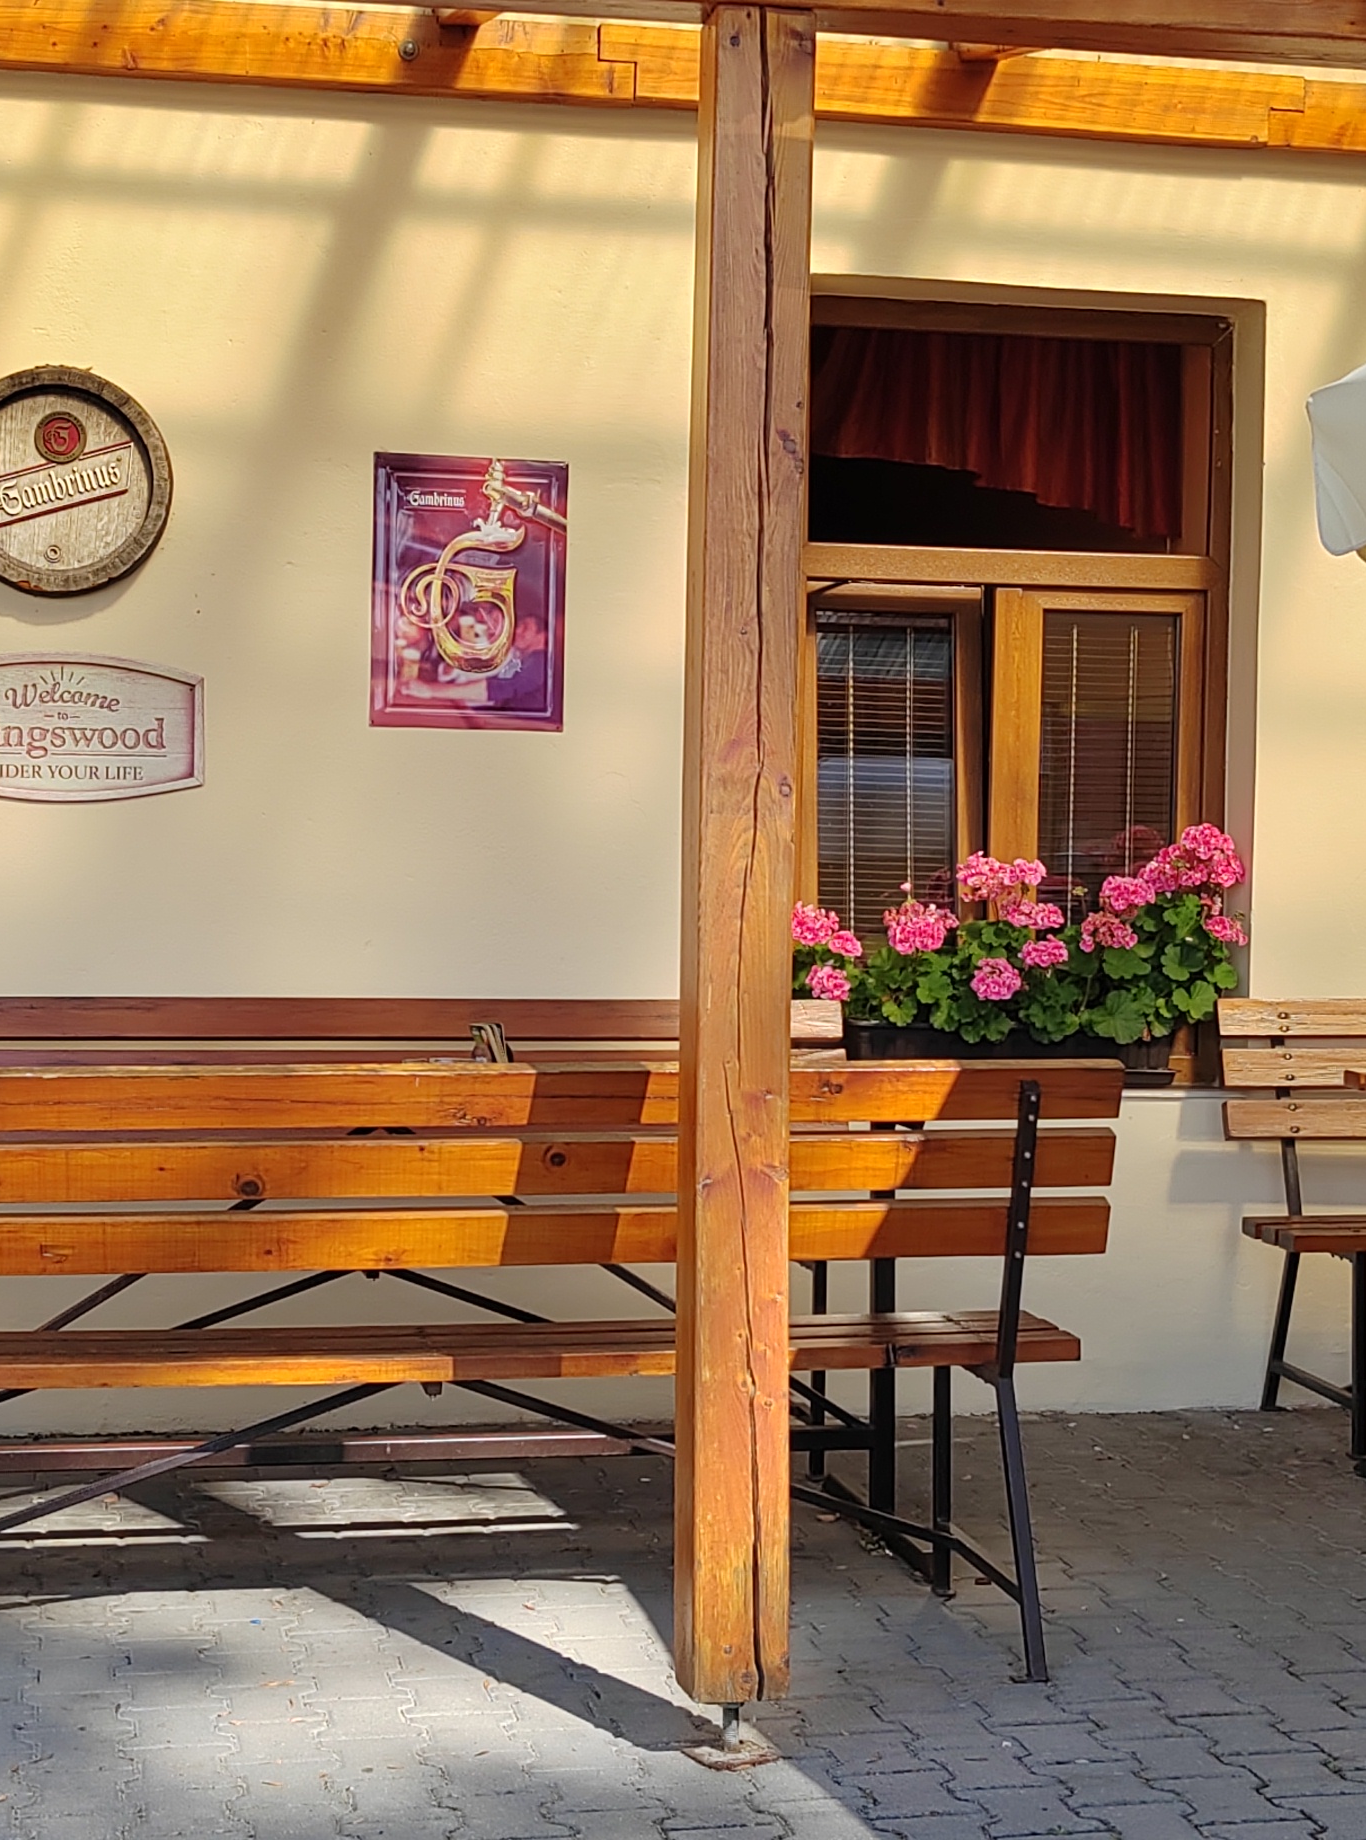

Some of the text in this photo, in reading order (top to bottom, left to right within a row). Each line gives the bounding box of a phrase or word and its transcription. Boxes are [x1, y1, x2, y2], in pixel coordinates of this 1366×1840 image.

[407, 490, 465, 507] Gambrinus
[4, 682, 121, 713] Welcome
[57, 711, 69, 721] to
[47, 764, 102, 780] YOUR
[104, 766, 144, 781] LIFE
